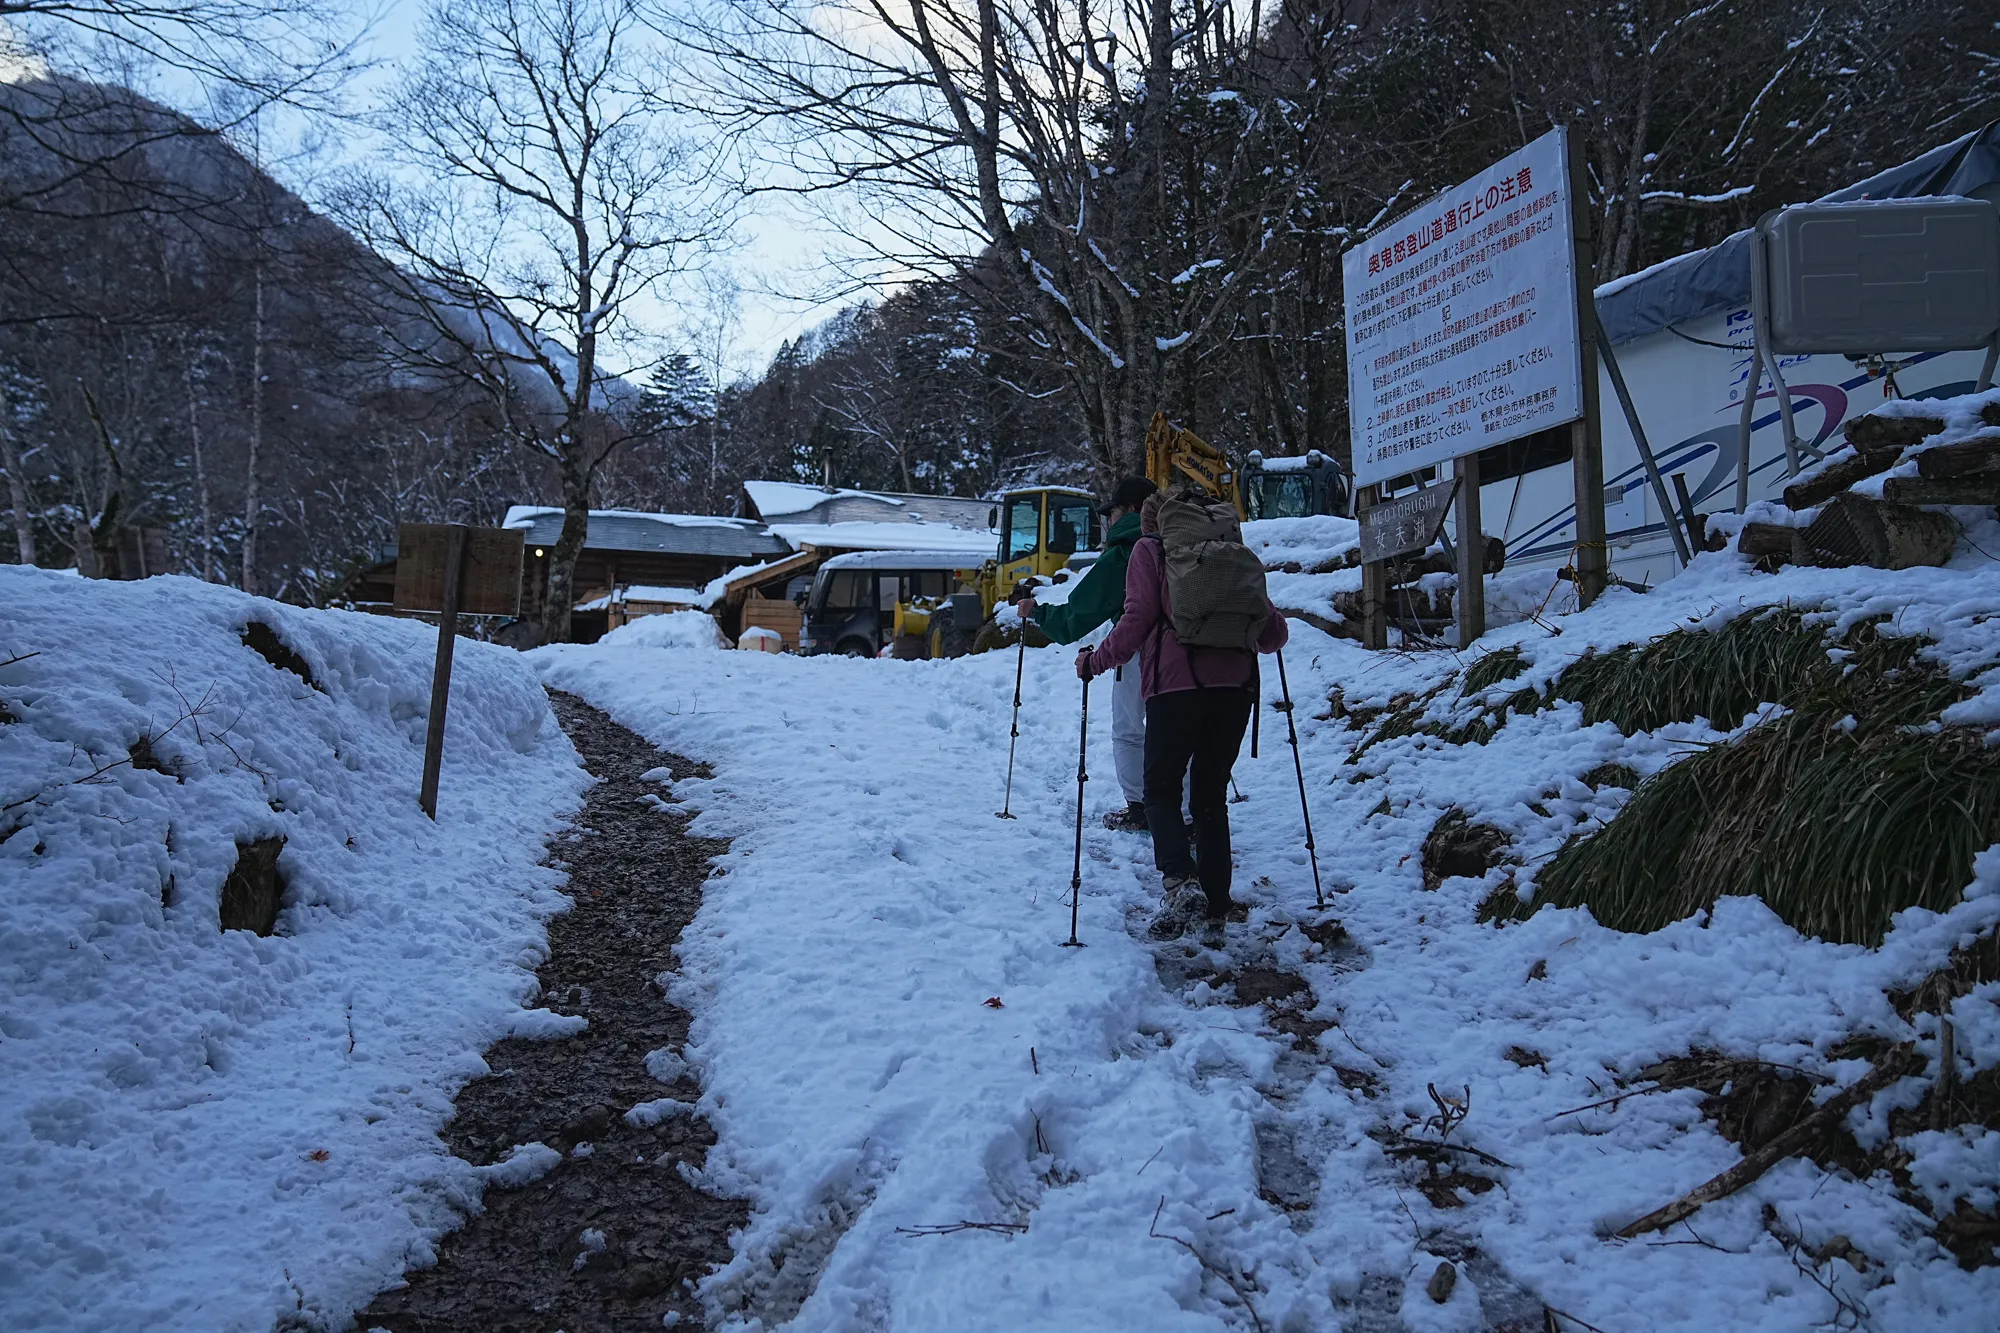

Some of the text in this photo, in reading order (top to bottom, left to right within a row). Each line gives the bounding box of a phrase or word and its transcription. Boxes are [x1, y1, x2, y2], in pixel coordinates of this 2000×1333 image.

[1367, 165, 1533, 277] 奥鬼怒登山道通行上の注意
[1441, 303, 1451, 323] 記
[1363, 363, 1368, 377] 1
[1480, 386, 1558, 424] 栃木県今市林務事務所
[1502, 402, 1554, 428] 0288-21-1178
[1366, 416, 1373, 430] 2
[1367, 434, 1373, 448] 3
[1187, 456, 1214, 480] KOMATSU
[1366, 452, 1373, 465] 4
[1369, 493, 1436, 527] MEOTOBUCHI
